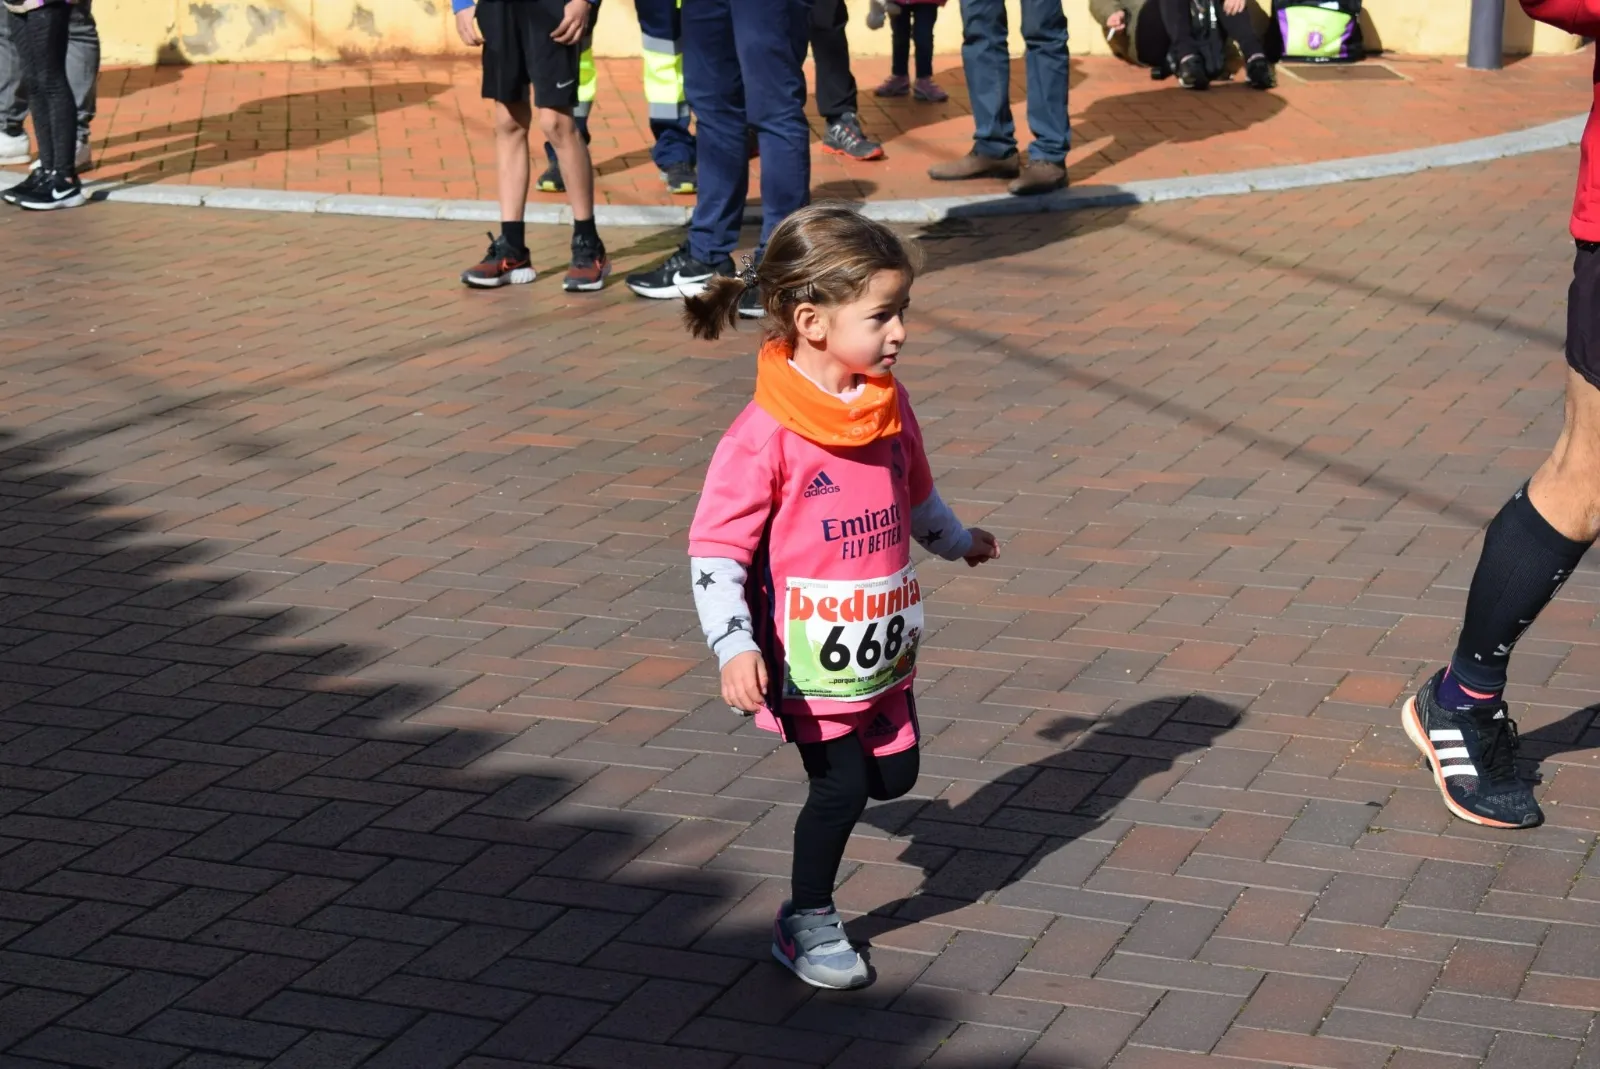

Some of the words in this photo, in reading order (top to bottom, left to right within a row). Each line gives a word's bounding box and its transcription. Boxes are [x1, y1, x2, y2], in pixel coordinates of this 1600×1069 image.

[804, 485, 841, 498] adidas
[842, 539, 864, 560] FLY
[868, 525, 902, 554] BETTER
[789, 576, 921, 622] bedunia
[820, 614, 905, 672] 668
